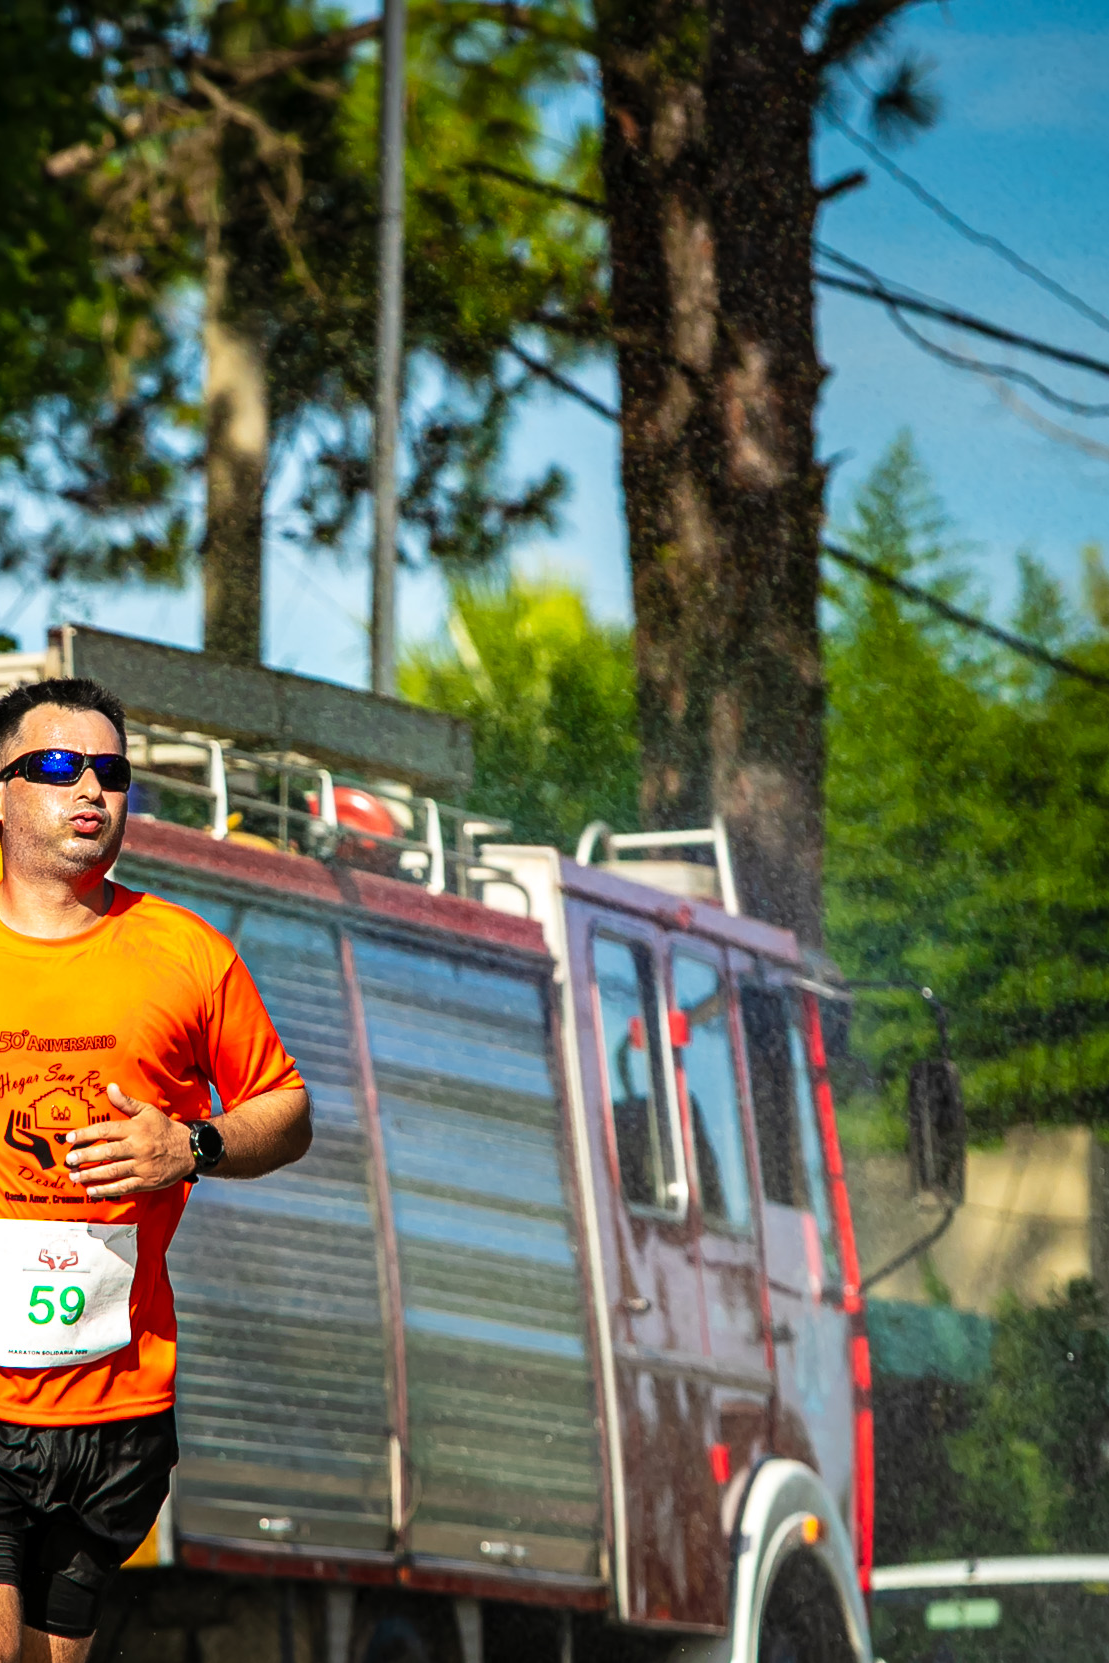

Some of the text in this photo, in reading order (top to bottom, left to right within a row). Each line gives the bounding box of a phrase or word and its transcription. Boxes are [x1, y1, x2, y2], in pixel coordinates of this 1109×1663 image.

[44, 1063, 75, 1082] San
[18, 1165, 66, 1190] Desde
[27, 1285, 86, 1326] 59
